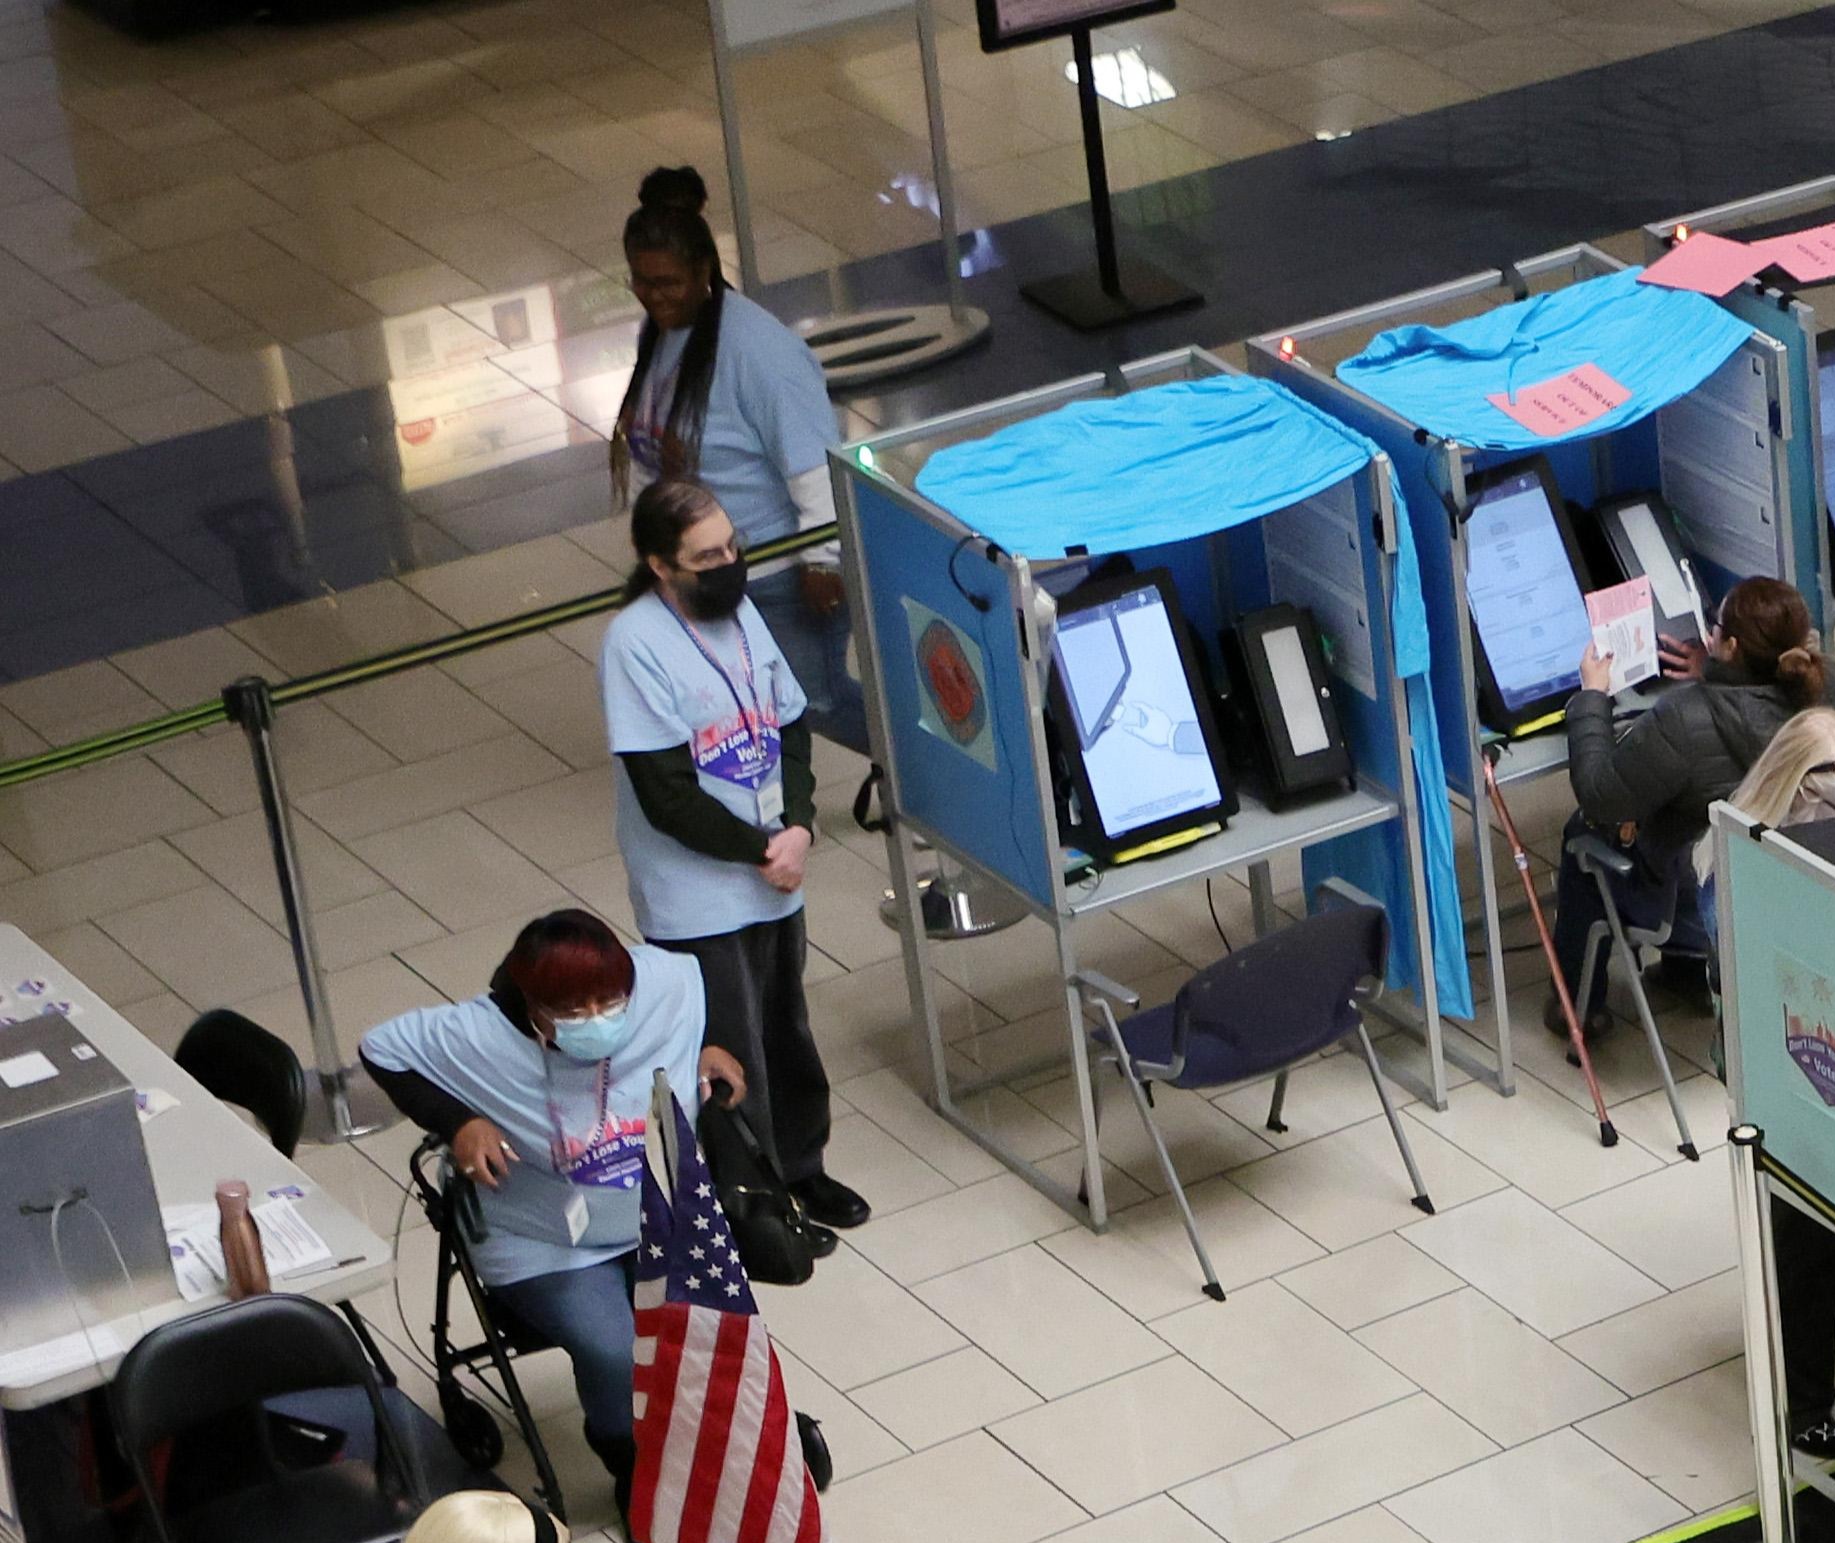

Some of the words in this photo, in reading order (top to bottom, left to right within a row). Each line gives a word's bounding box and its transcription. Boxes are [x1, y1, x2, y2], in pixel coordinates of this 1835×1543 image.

[698, 741, 728, 767] Don't
[592, 1140, 621, 1161] Lose
[621, 1133, 646, 1148] You
